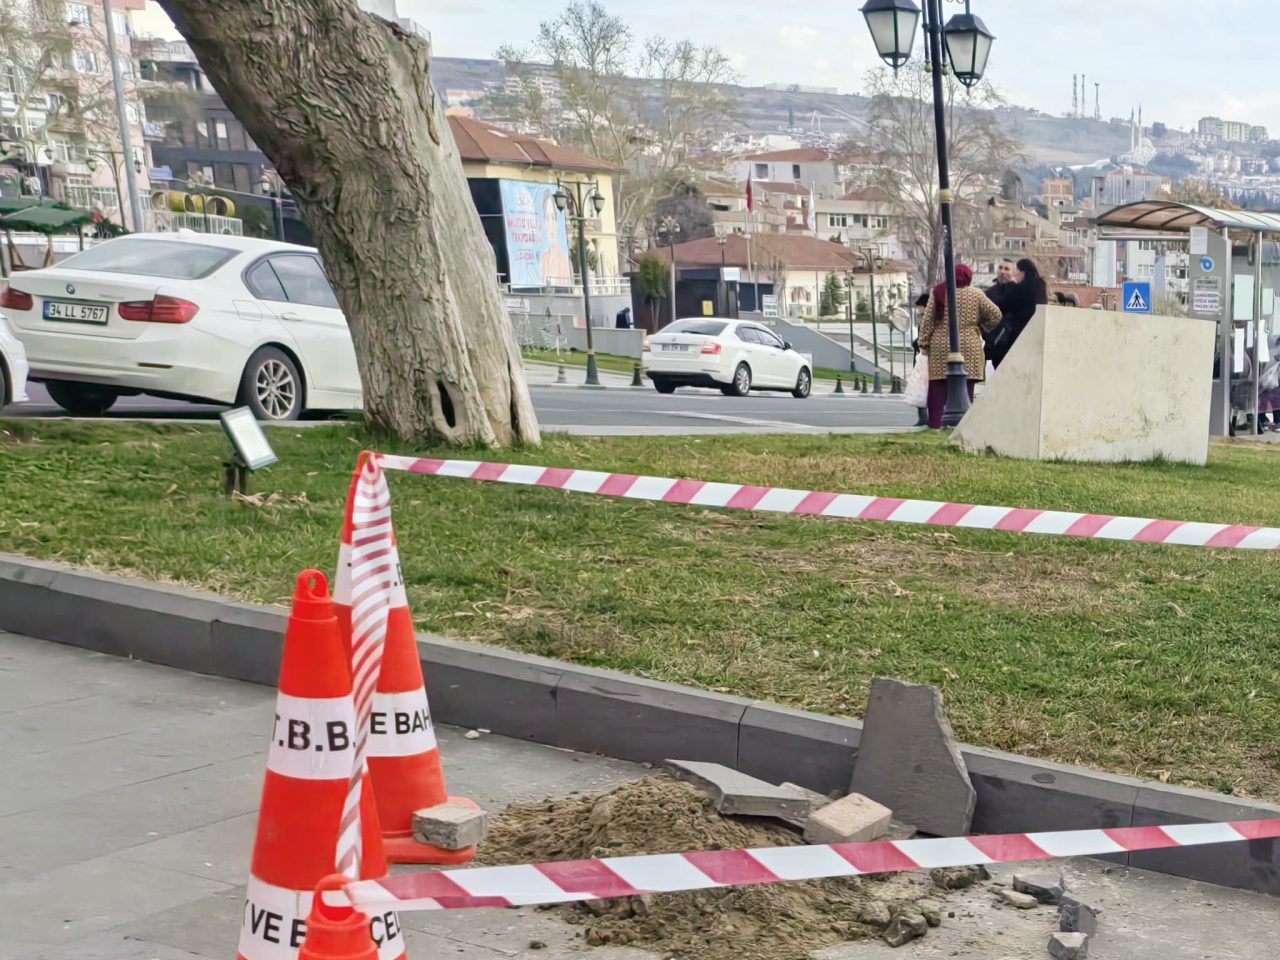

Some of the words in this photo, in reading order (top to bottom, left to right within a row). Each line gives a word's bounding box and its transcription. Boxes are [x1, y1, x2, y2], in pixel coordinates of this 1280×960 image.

[50, 304, 61, 316] 34
[65, 306, 76, 317] LL
[81, 306, 104, 319] 5767
